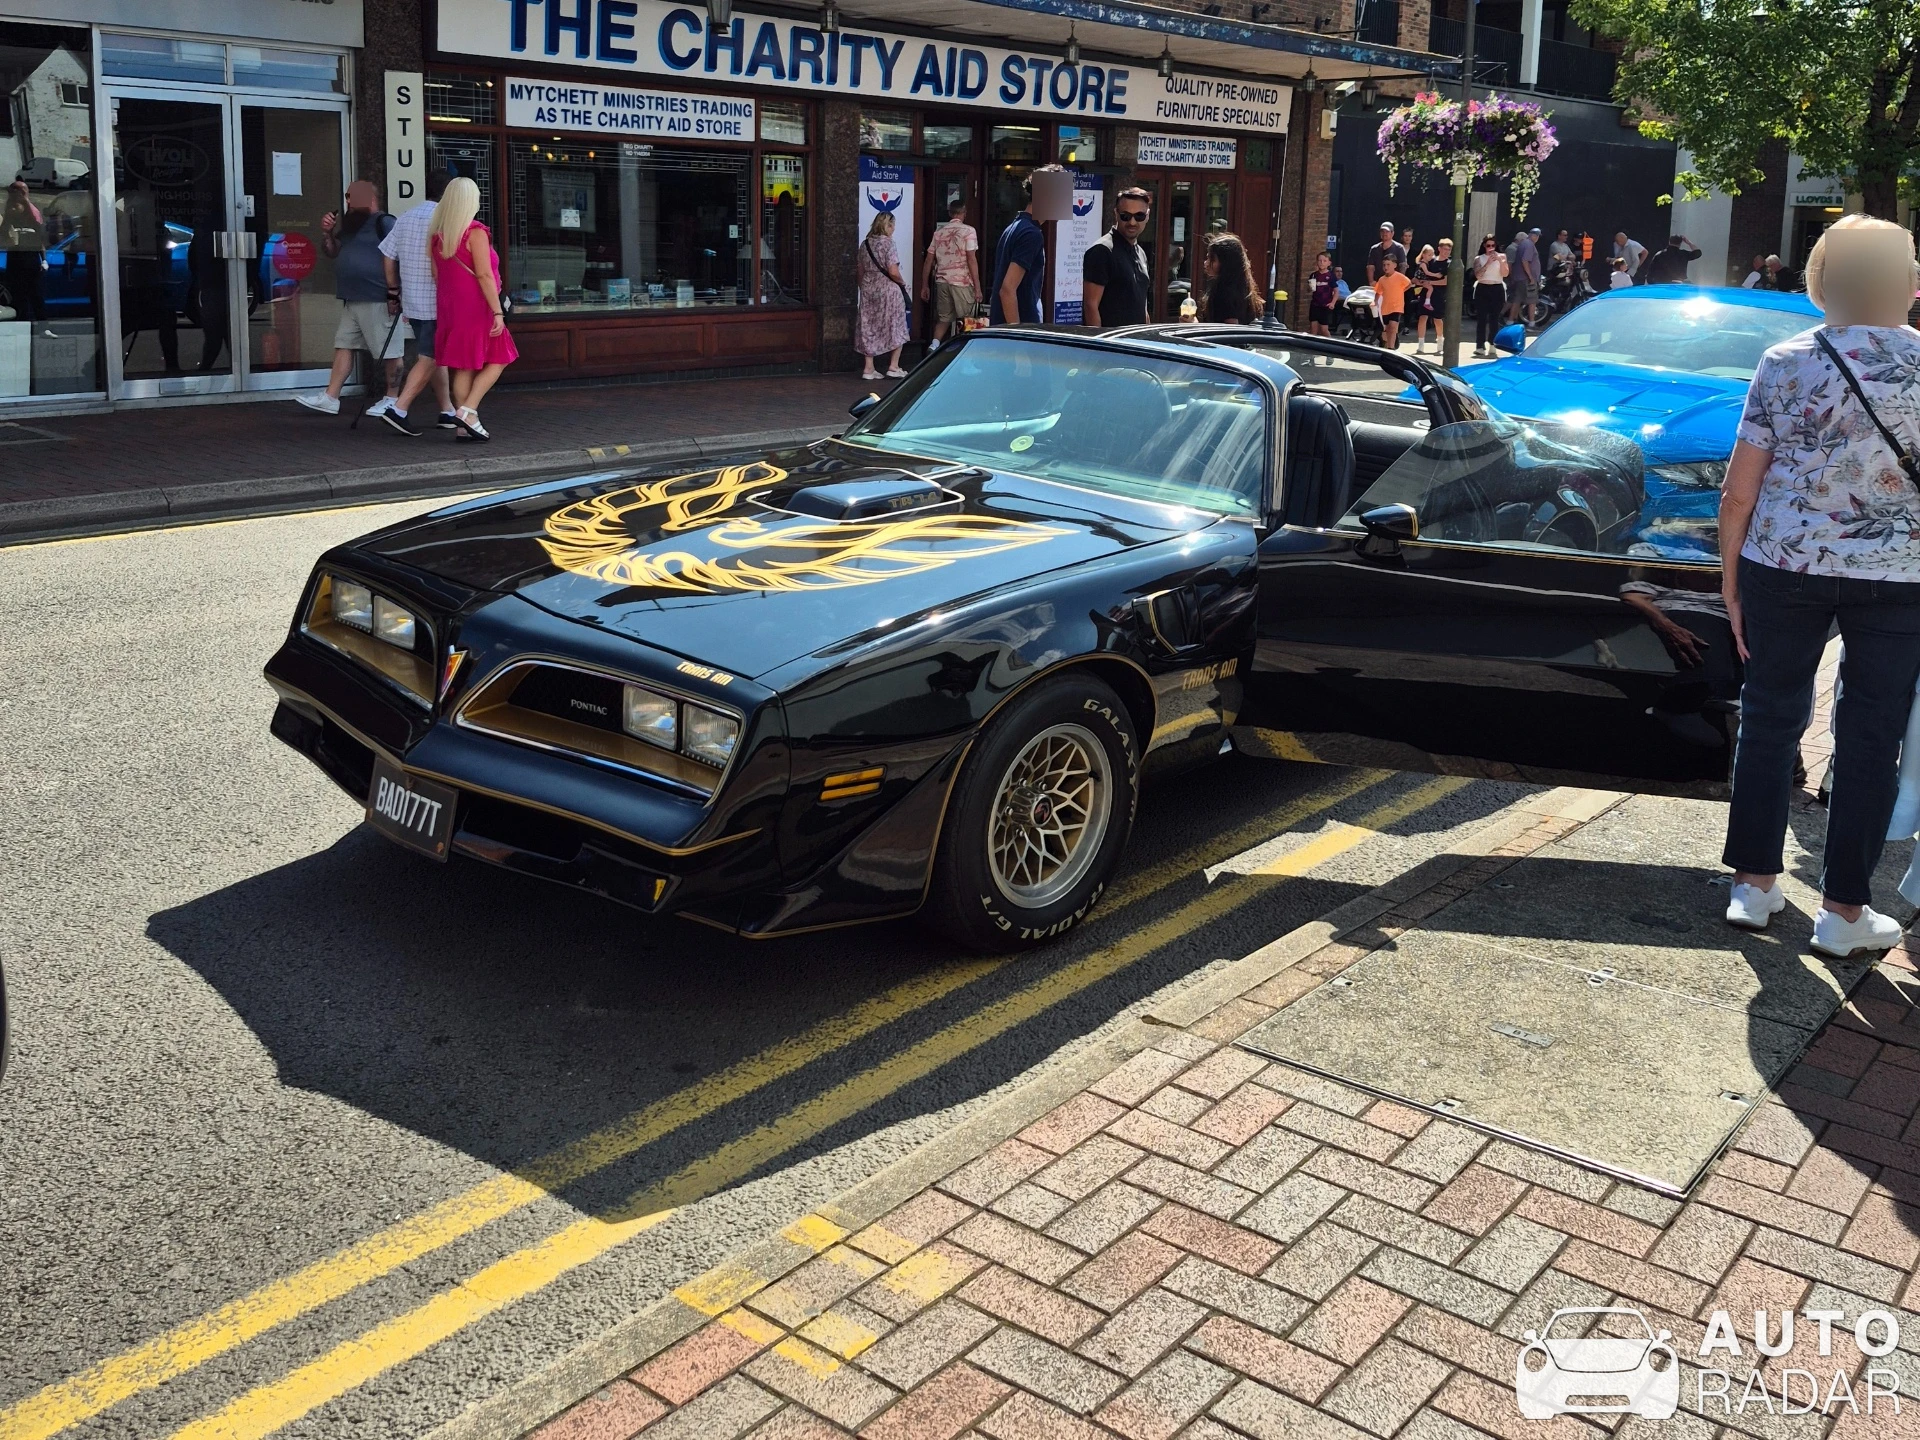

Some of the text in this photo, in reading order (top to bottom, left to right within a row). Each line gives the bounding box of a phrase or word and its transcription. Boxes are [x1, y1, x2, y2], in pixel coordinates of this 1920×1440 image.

[504, 0, 1129, 114] THE CHARITY AID STORE
[510, 84, 752, 118] MYTCHETT MINISTRIES TRADING
[1165, 77, 1278, 104] QUALITY PRE-OWNED
[535, 107, 741, 136] AS THE CHARITY AID STORE
[1157, 100, 1281, 128] FURNITURE SPECIALIST
[1138, 150, 1231, 165] AS THE CHARITY AID STORE
[1168, 138, 1207, 151] MINISTRIES
[1208, 141, 1236, 152] TRADING
[1796, 195, 1833, 204] LLOYDS
[676, 661, 734, 686] TRANS AM
[1182, 657, 1238, 690] TRANS AM
[571, 699, 608, 716] PONTIAC
[1083, 698, 1137, 793] GALAXY
[375, 776, 443, 837] BAD177T
